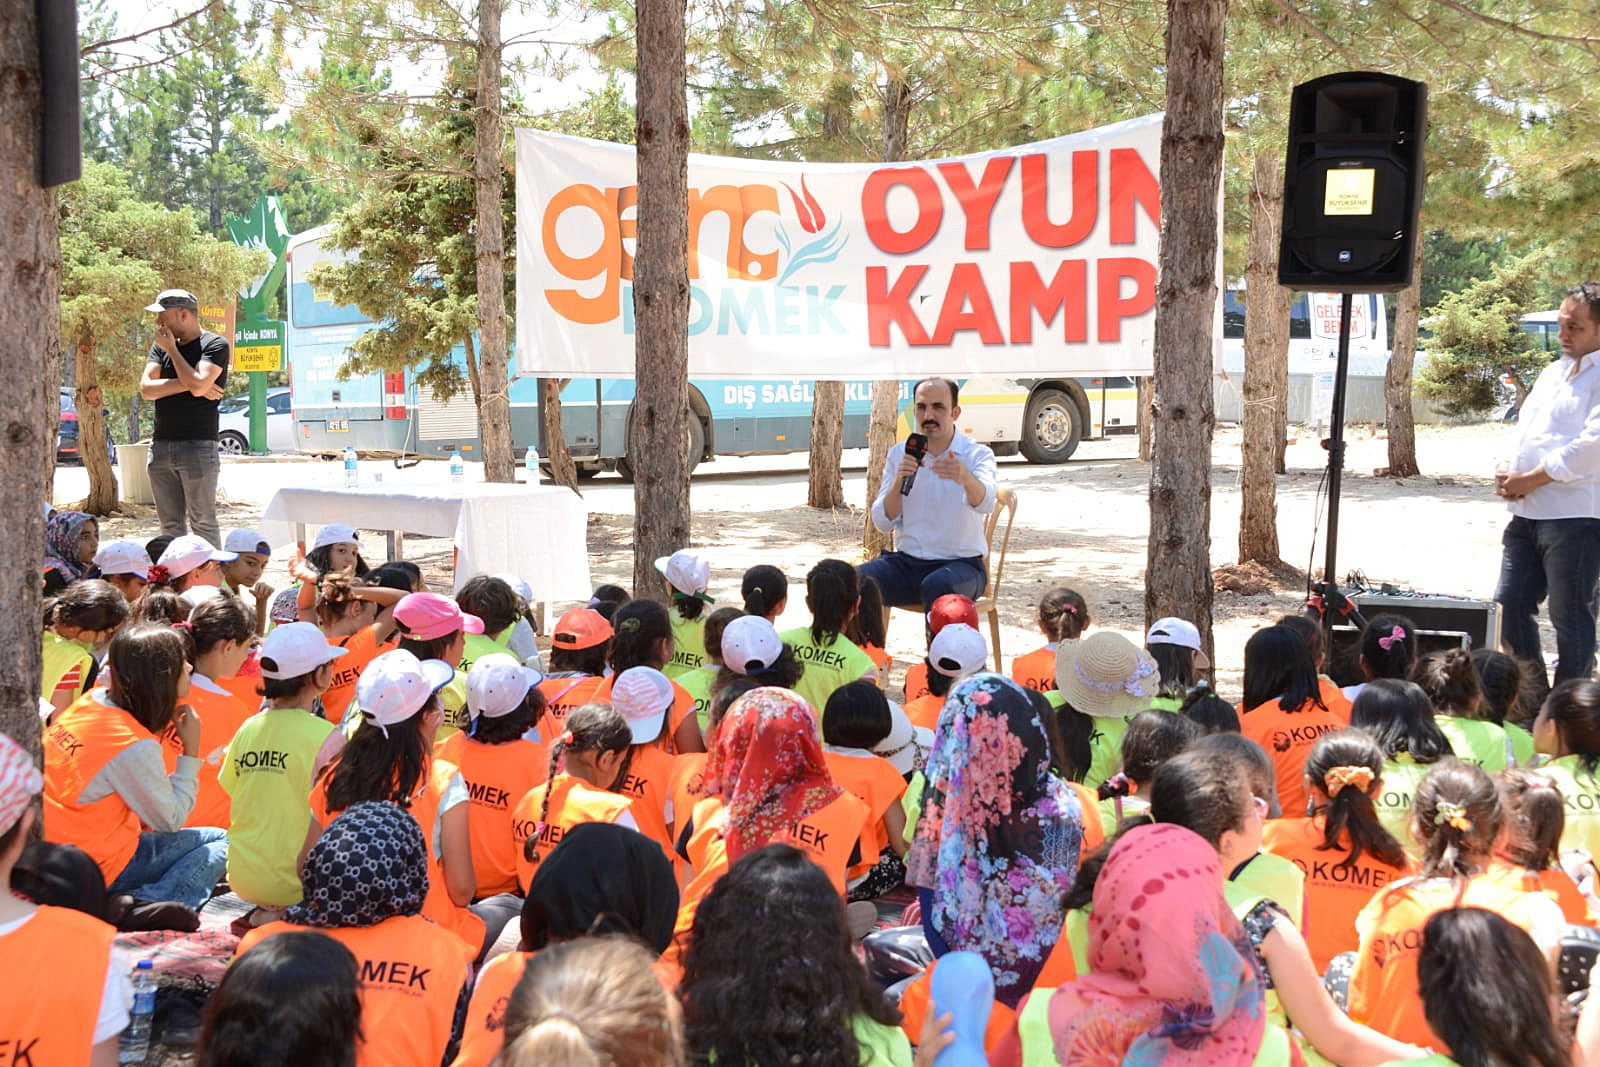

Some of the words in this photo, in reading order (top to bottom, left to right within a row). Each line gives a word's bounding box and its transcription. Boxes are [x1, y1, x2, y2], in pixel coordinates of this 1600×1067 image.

[861, 148, 1161, 255] OYUN
[1316, 304, 1363, 319] GELEEK
[669, 650, 705, 669] MEK
[793, 644, 847, 670] KOMEK
[329, 664, 361, 688] MEK
[464, 780, 511, 808] MEK
[1312, 860, 1393, 889] KOME
[361, 959, 432, 991] MEK
